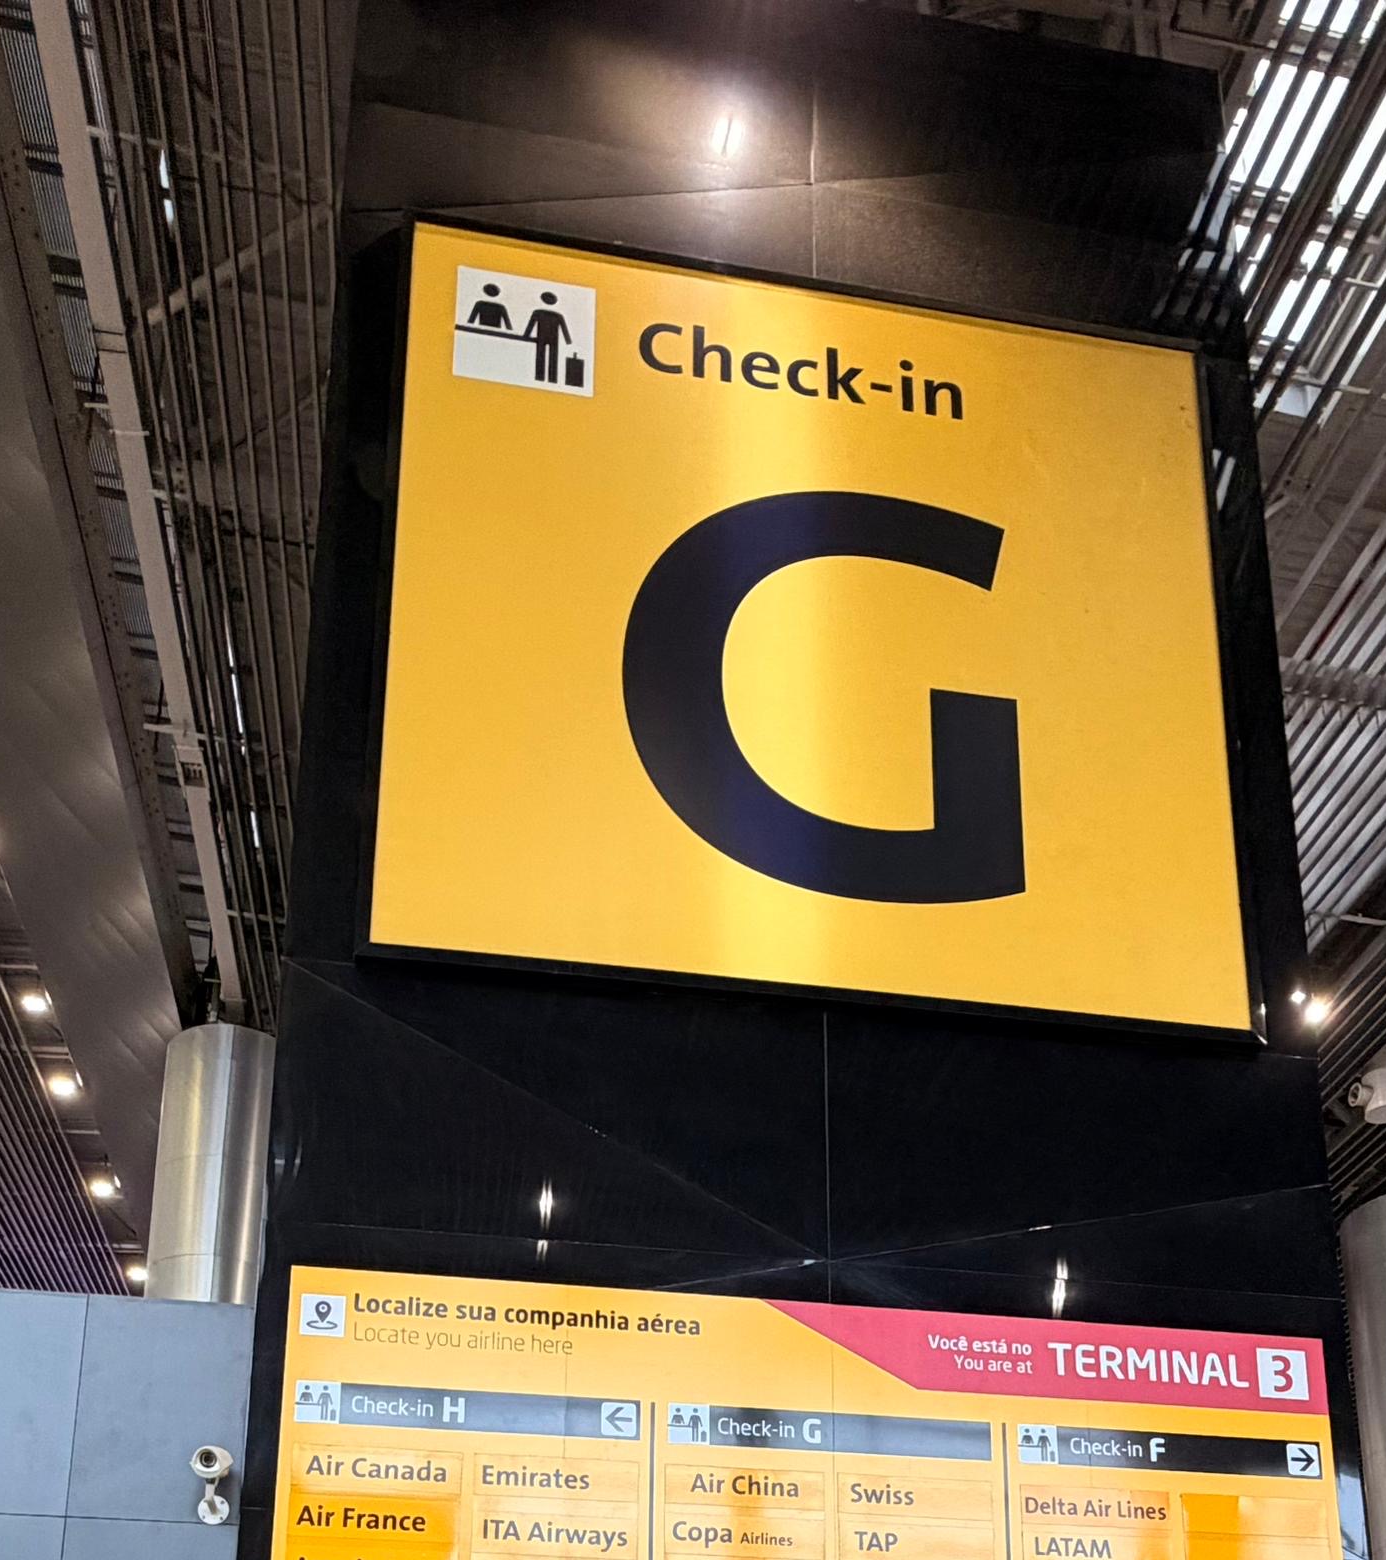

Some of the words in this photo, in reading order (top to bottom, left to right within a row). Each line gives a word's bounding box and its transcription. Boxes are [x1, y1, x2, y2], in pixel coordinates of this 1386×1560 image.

[639, 322, 965, 421] Check-in
[622, 490, 1026, 904] G
[354, 1293, 448, 1318] Localize
[456, 1303, 496, 1322] sua
[504, 1306, 629, 1331] companhia
[637, 1313, 700, 1335] aérea
[353, 1321, 419, 1345] Locate
[426, 1330, 461, 1349] you
[467, 1330, 525, 1353] airline
[531, 1333, 573, 1355] here
[927, 1333, 968, 1351] Você
[972, 1337, 1007, 1354] está
[1011, 1342, 1032, 1356] no
[953, 1354, 985, 1372] You
[988, 1359, 1012, 1373] are
[1016, 1360, 1033, 1374] at
[1047, 1341, 1250, 1389] TERMINAL
[1271, 1355, 1294, 1393] 3
[351, 1395, 434, 1418] Check-in
[442, 1396, 465, 1424] H
[717, 1417, 795, 1439] Check-in
[802, 1418, 822, 1444] G
[1070, 1437, 1143, 1458] Check-in
[1149, 1437, 1166, 1463] F
[305, 1455, 345, 1477] Air
[351, 1458, 447, 1483] Canada
[482, 1465, 590, 1491] Emirates
[690, 1473, 725, 1494] Air
[732, 1475, 799, 1498] China
[850, 1483, 914, 1507] Swiss
[296, 1505, 335, 1528] Air
[342, 1507, 426, 1532] France
[1024, 1496, 1078, 1516] Delta
[1083, 1500, 1111, 1518] Air
[1117, 1500, 1167, 1521] Lines
[482, 1519, 521, 1542] ITA
[528, 1522, 629, 1553] Airways
[672, 1520, 733, 1549] Copa
[740, 1532, 793, 1548] Airlines
[854, 1531, 899, 1554] TAP
[1034, 1536, 1113, 1559] LATAM
